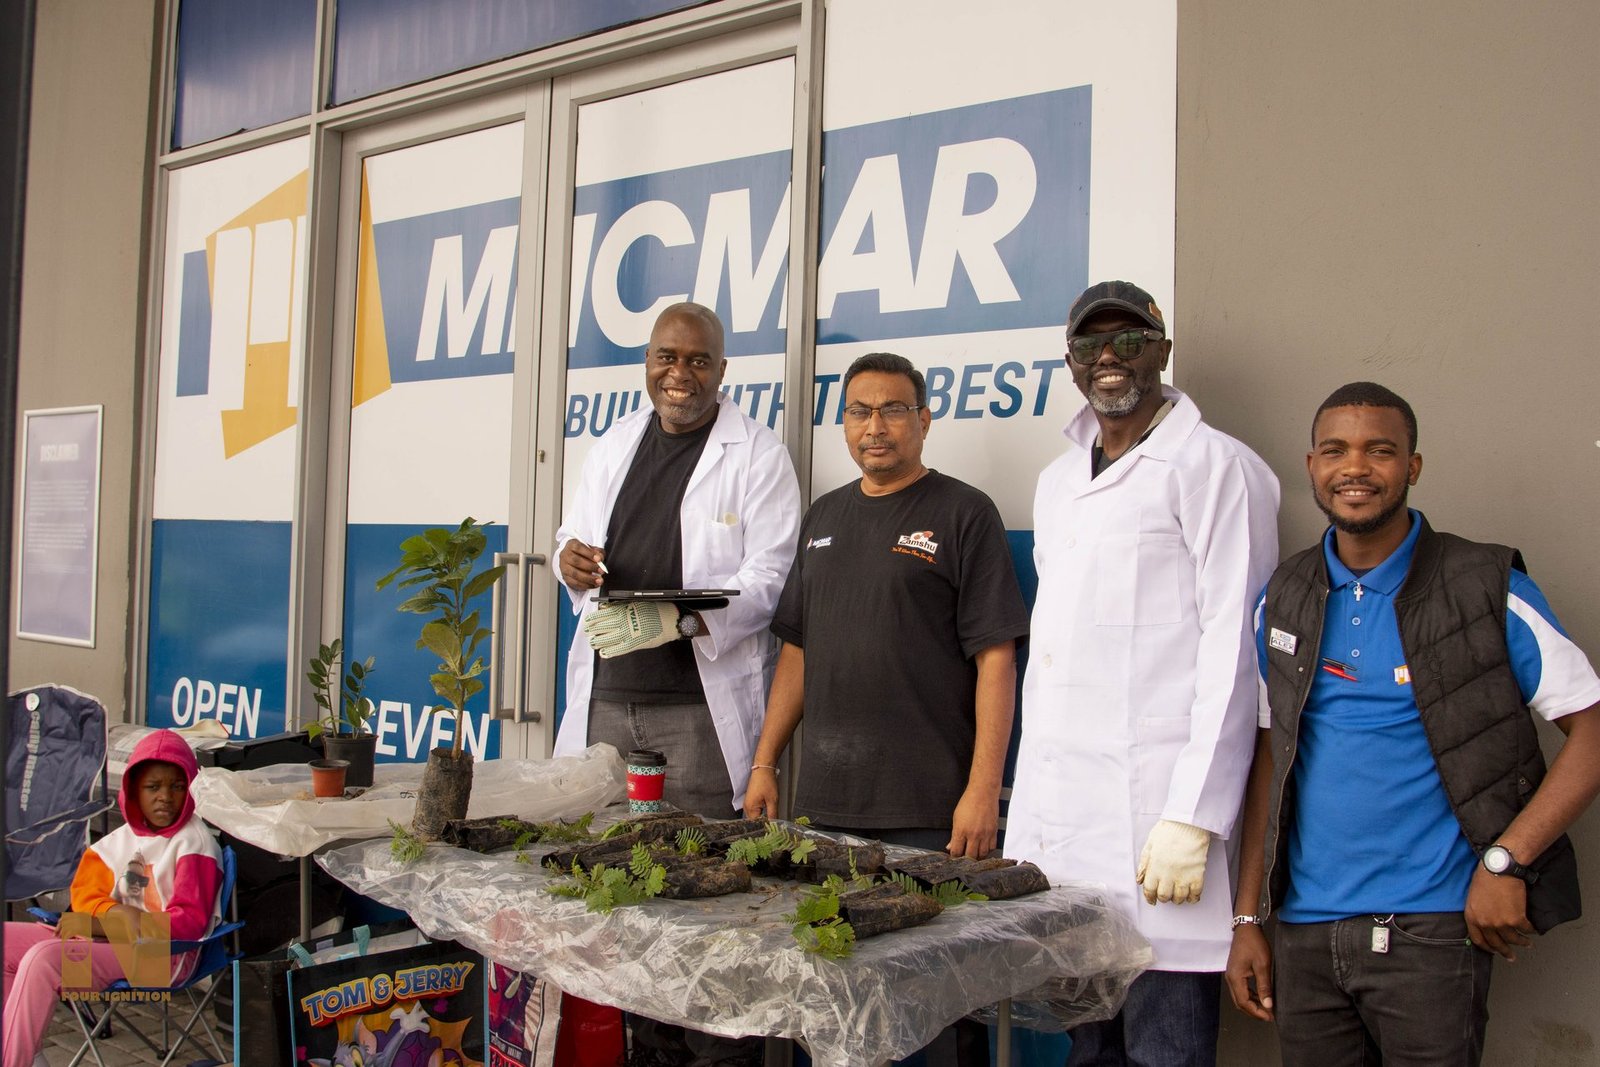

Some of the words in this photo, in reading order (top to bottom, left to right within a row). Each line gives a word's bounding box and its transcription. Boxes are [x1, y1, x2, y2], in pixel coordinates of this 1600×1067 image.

[415, 137, 1037, 363] MICMAR
[564, 390, 642, 438] BUI
[925, 359, 1066, 421] BEST
[899, 535, 936, 552] Zamshu
[172, 676, 262, 739] OPEN
[302, 977, 371, 1026] TOM
[371, 973, 393, 1005] &
[394, 961, 475, 1000] JERRY
